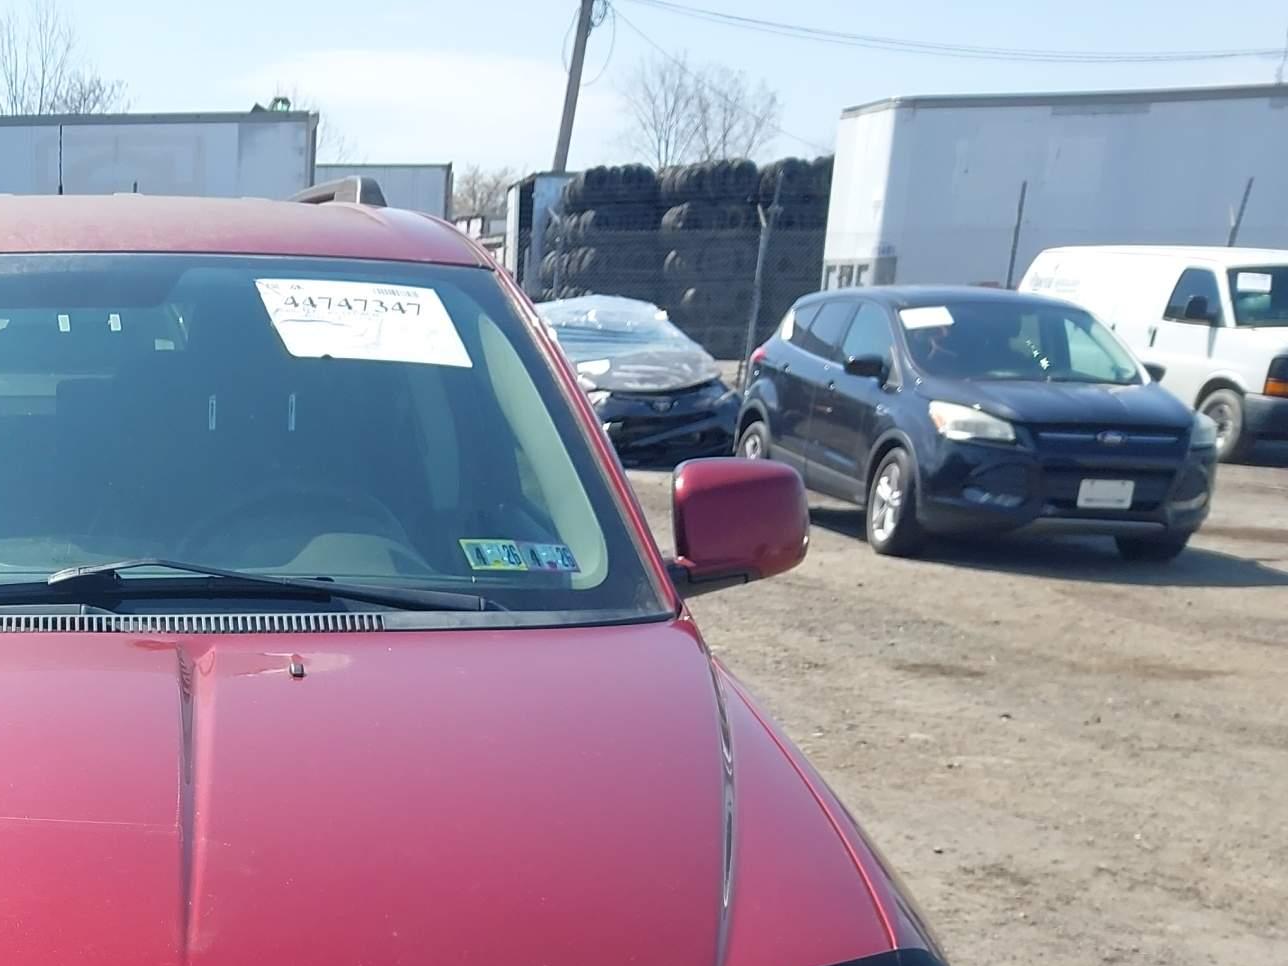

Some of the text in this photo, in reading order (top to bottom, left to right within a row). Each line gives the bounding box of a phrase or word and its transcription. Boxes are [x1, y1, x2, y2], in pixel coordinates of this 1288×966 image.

[284, 295, 421, 316] 44747347
[502, 544, 522, 566] 26
[556, 547, 576, 567] 26
